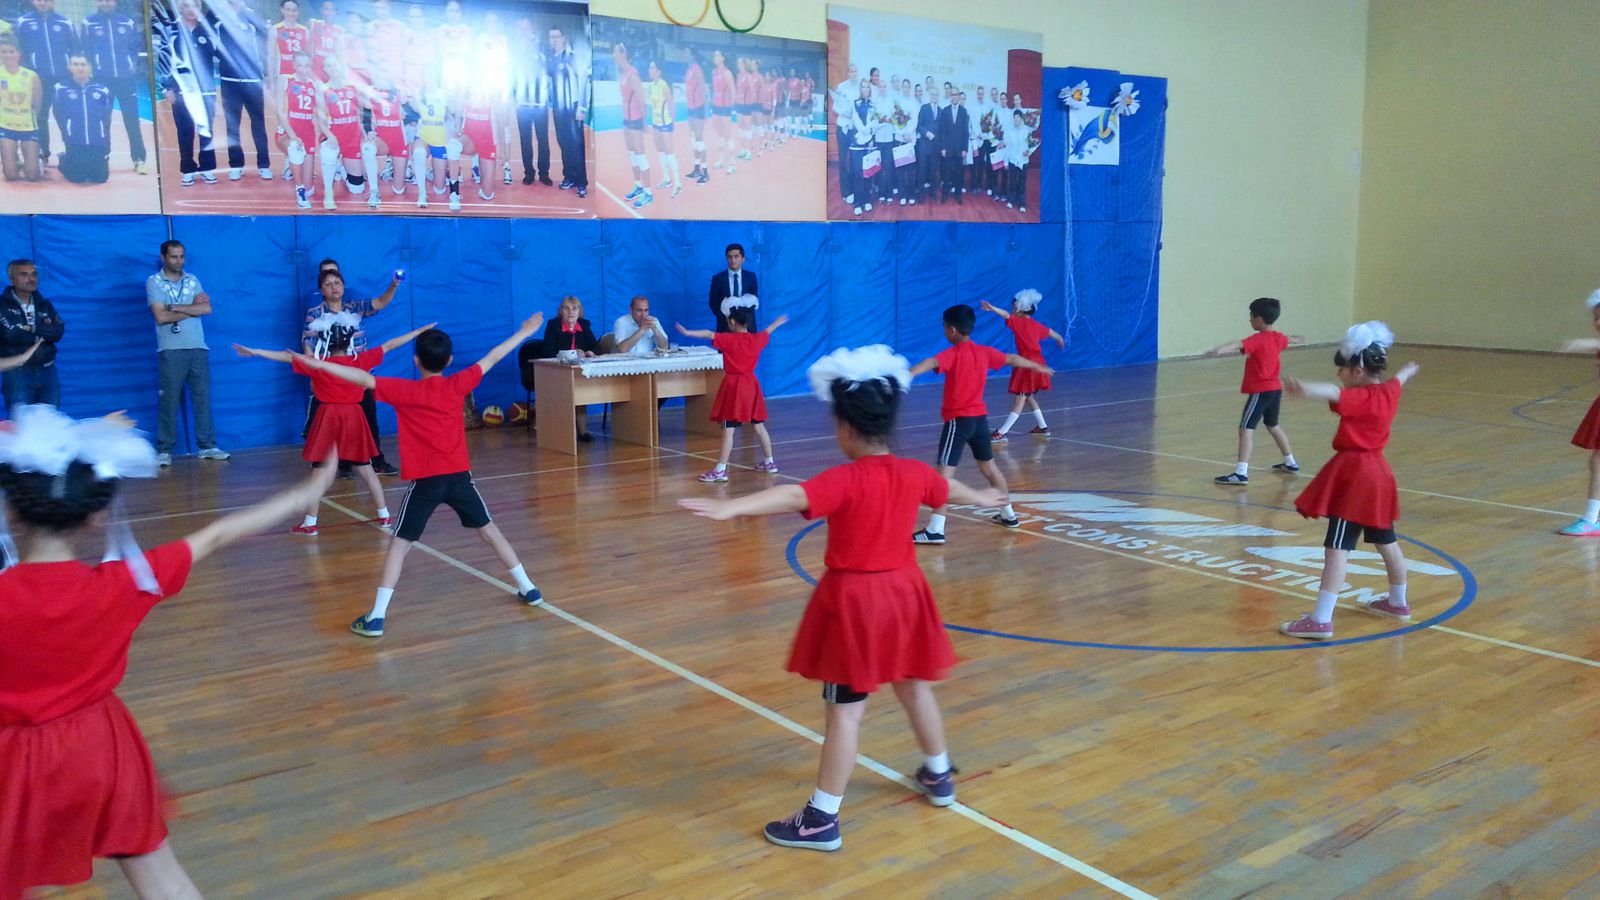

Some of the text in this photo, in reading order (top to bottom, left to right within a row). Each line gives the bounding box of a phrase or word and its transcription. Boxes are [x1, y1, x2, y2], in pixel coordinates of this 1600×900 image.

[286, 39, 301, 52] 13
[297, 94, 312, 110] 12
[336, 99, 351, 115] 17
